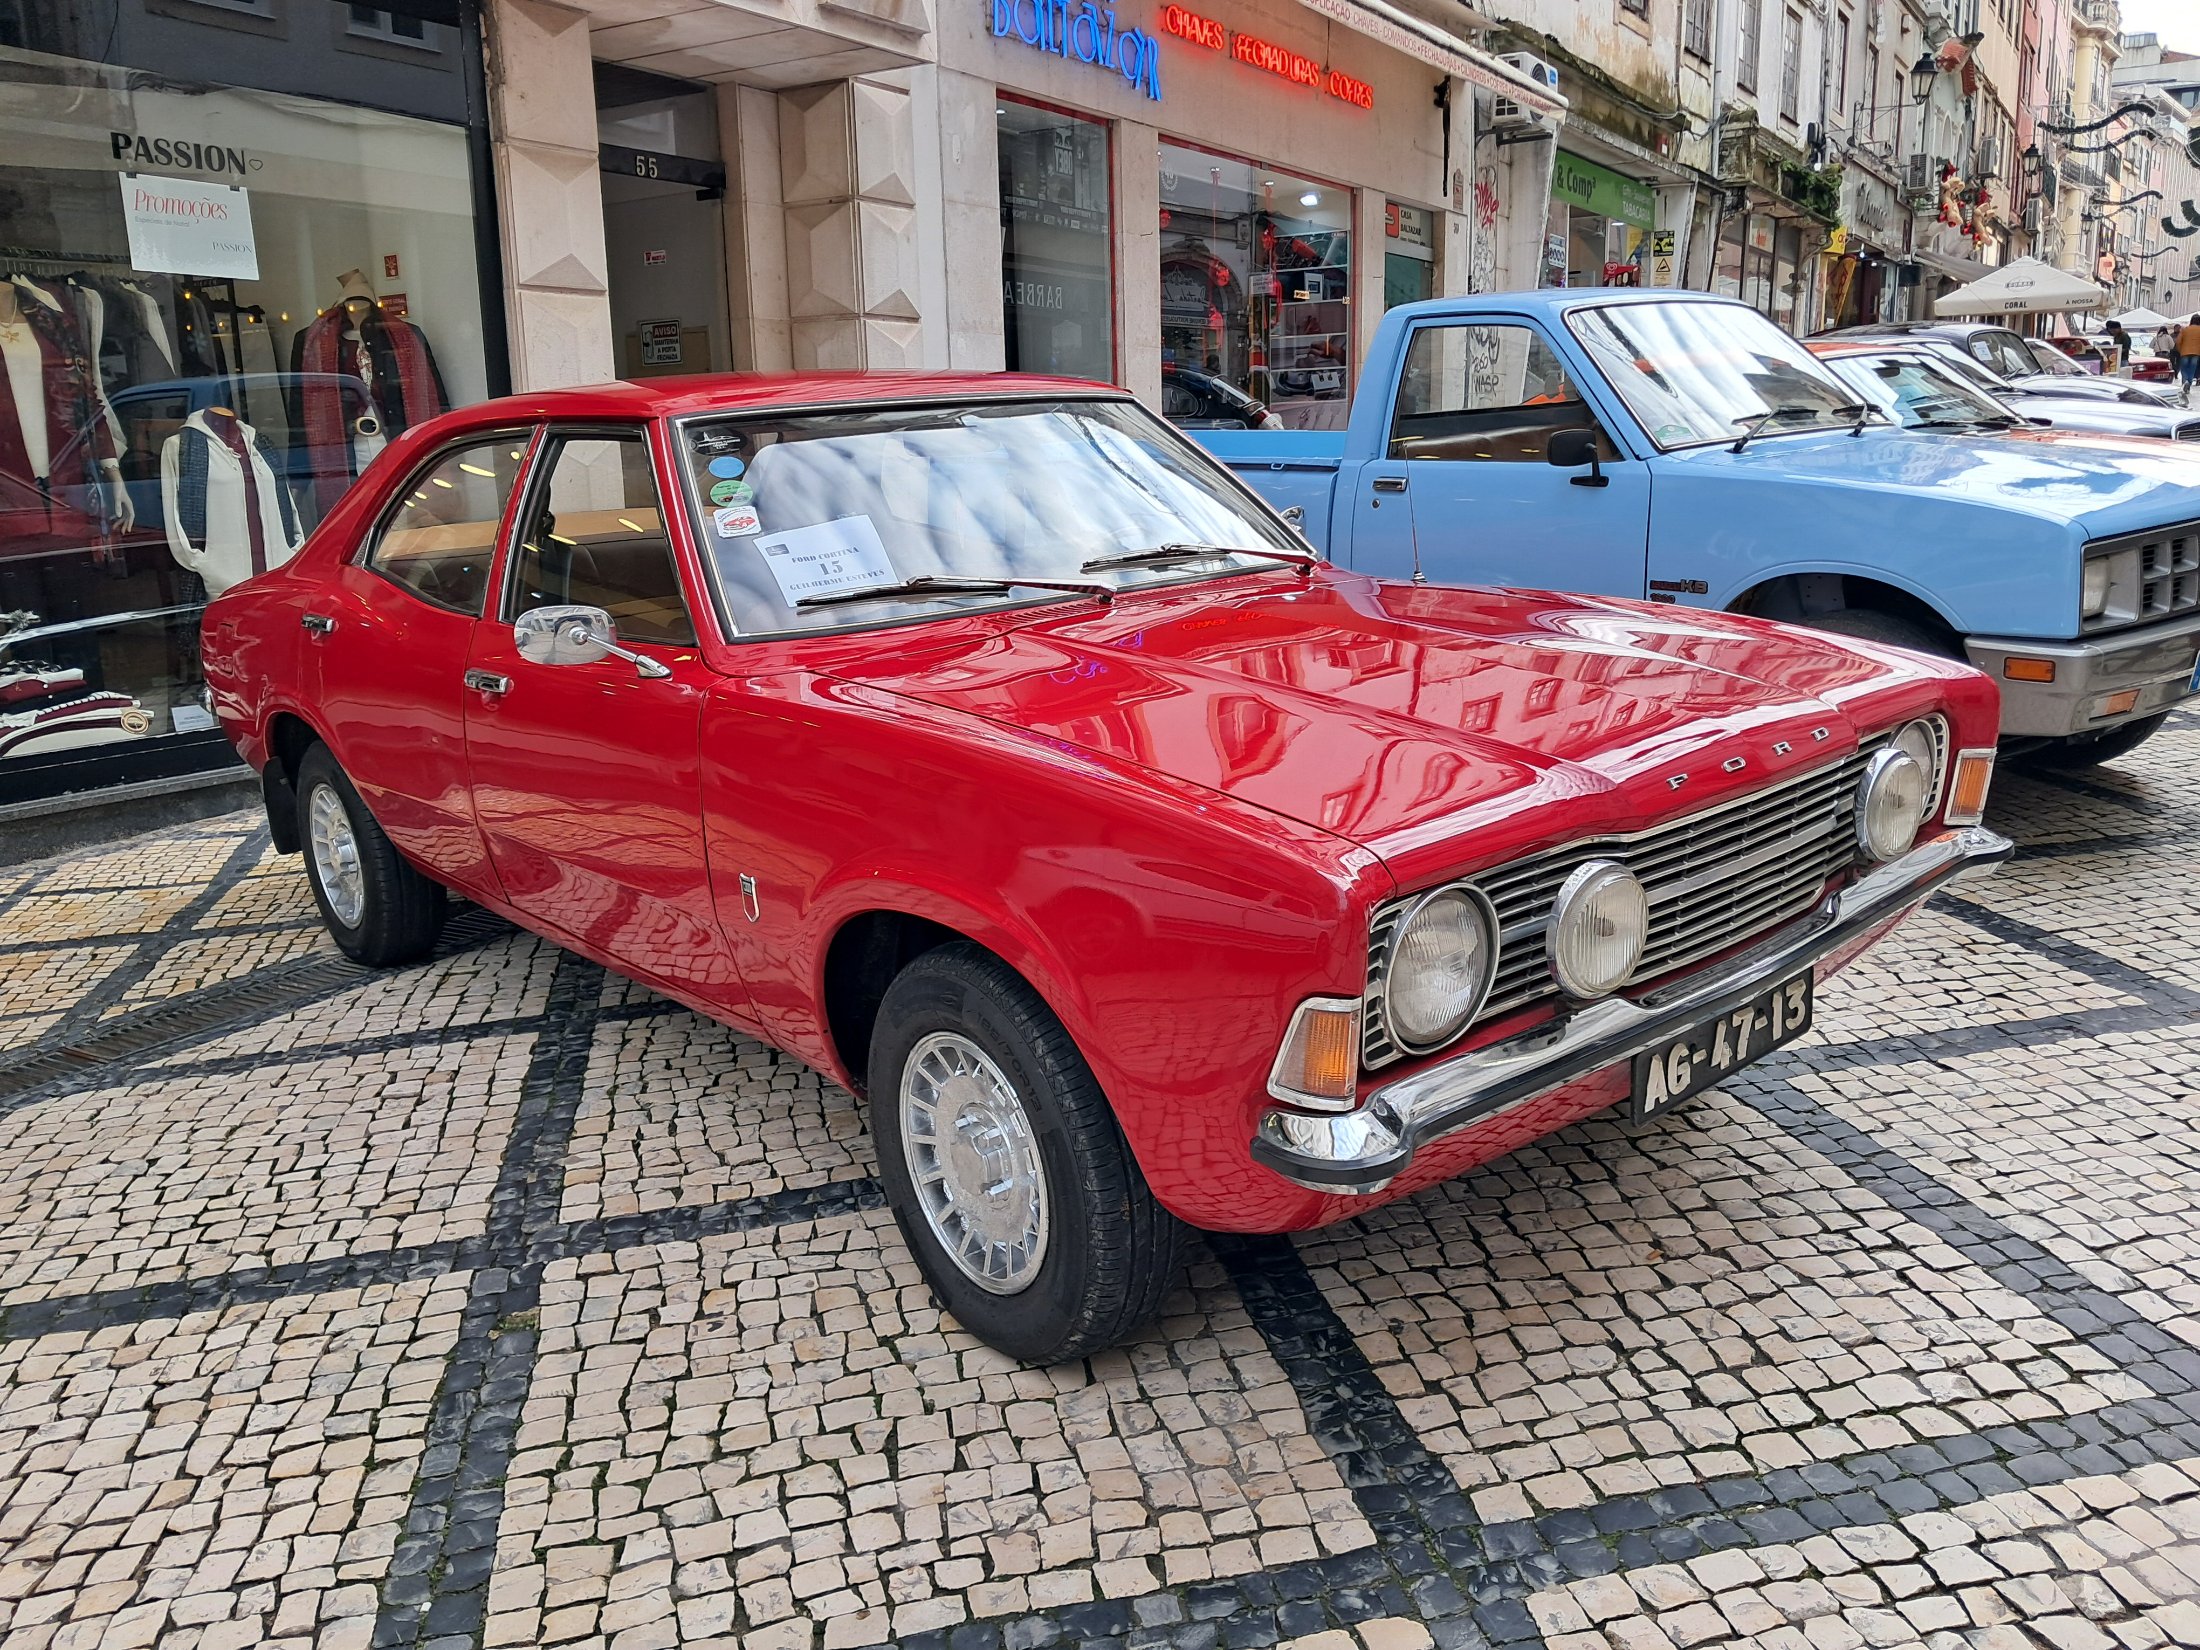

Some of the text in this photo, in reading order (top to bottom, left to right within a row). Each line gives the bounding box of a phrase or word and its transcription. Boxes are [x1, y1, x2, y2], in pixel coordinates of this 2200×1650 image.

[1165, 5, 1374, 110] CHAVES FECHADURAS COFRES
[110, 131, 246, 175] PASSION
[636, 155, 658, 178] 55
[1556, 164, 1564, 189] &
[134, 188, 229, 224] Promoções
[1400, 209, 1412, 220] CASA
[1400, 223, 1422, 236] BALTAZAR
[212, 241, 252, 253] PASSION
[2004, 301, 2028, 310] CORAL
[654, 326, 676, 337] AVISO
[791, 546, 860, 563] FORD CORTINA
[819, 559, 844, 575] 15
[789, 568, 885, 590] GUILHERME ESTEVES
[1680, 578, 1709, 595] KB
[1666, 727, 1830, 790] FORD
[1644, 978, 1807, 1114] AG-47-13
